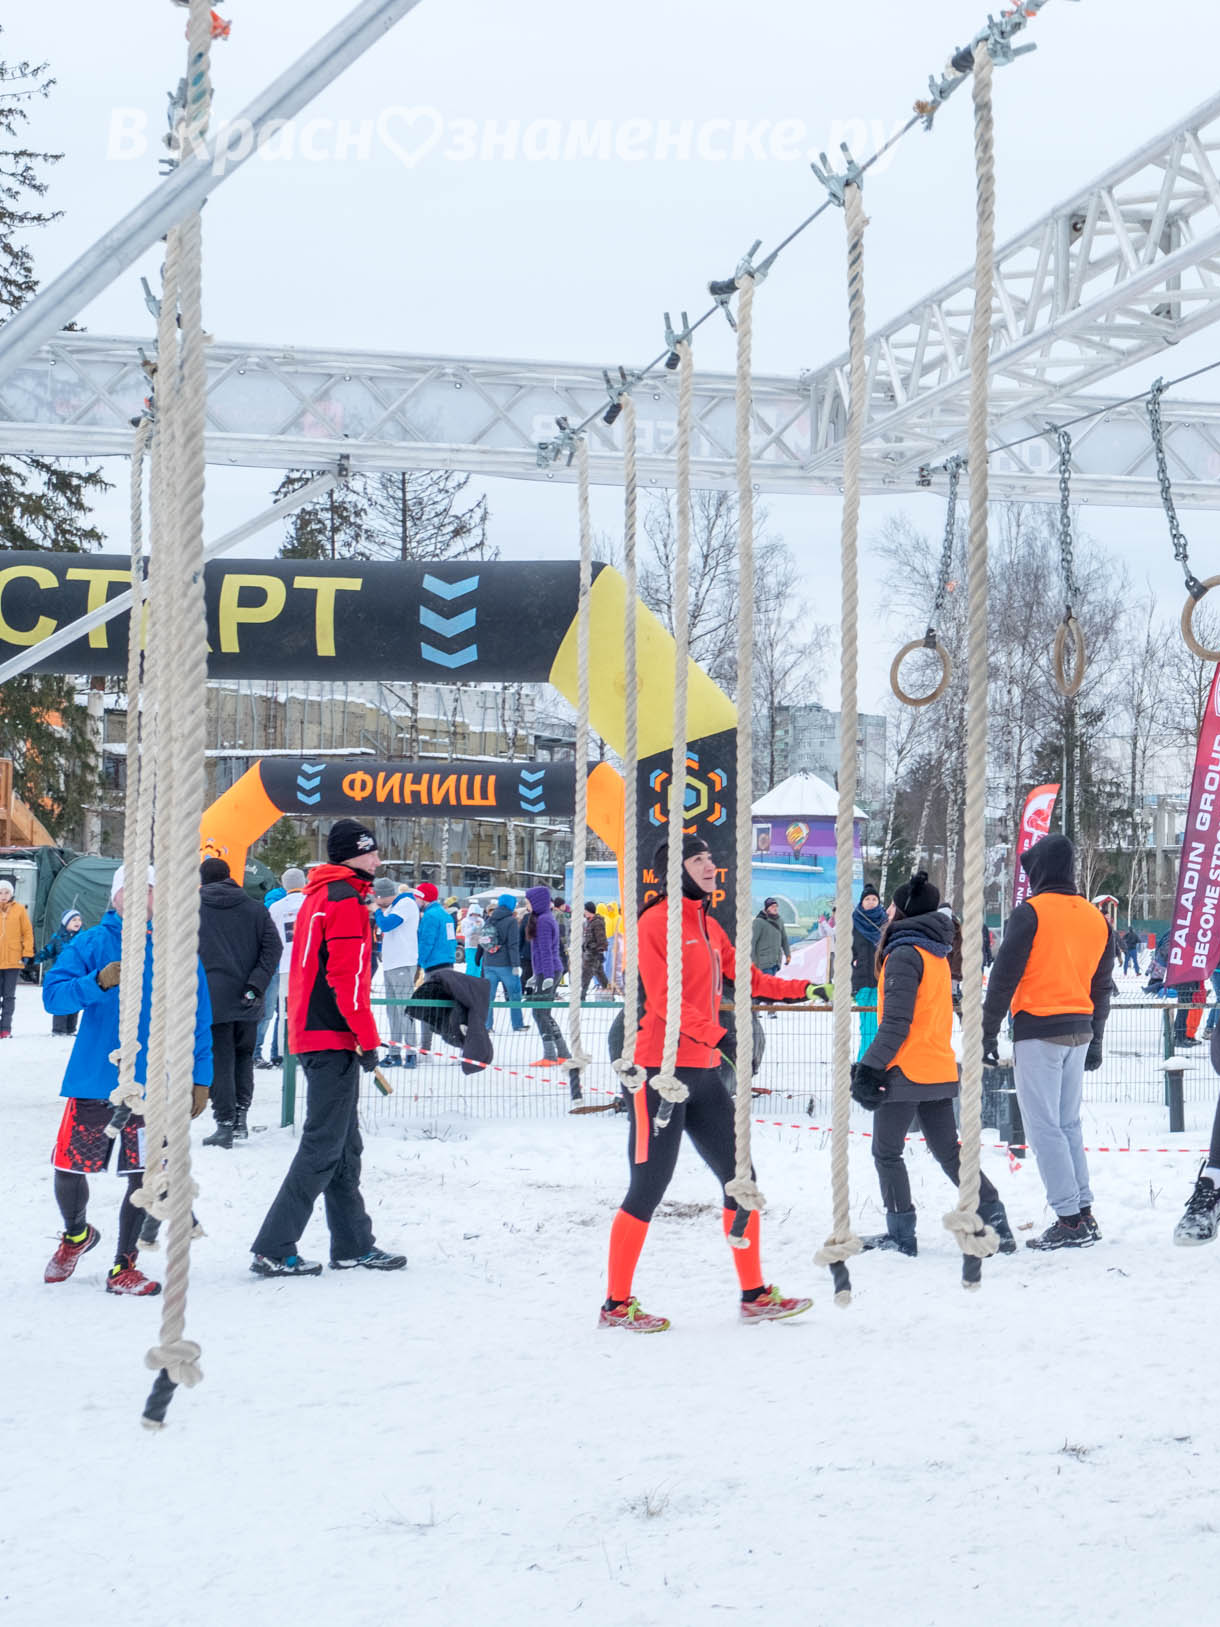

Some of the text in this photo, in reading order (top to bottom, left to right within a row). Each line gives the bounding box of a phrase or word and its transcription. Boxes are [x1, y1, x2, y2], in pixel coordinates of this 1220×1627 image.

[0, 565, 363, 657] СТРТ
[342, 771, 497, 806] ФИНИШ
[1170, 842, 1205, 965] PALADIN
[1192, 885, 1220, 968] BECOME
